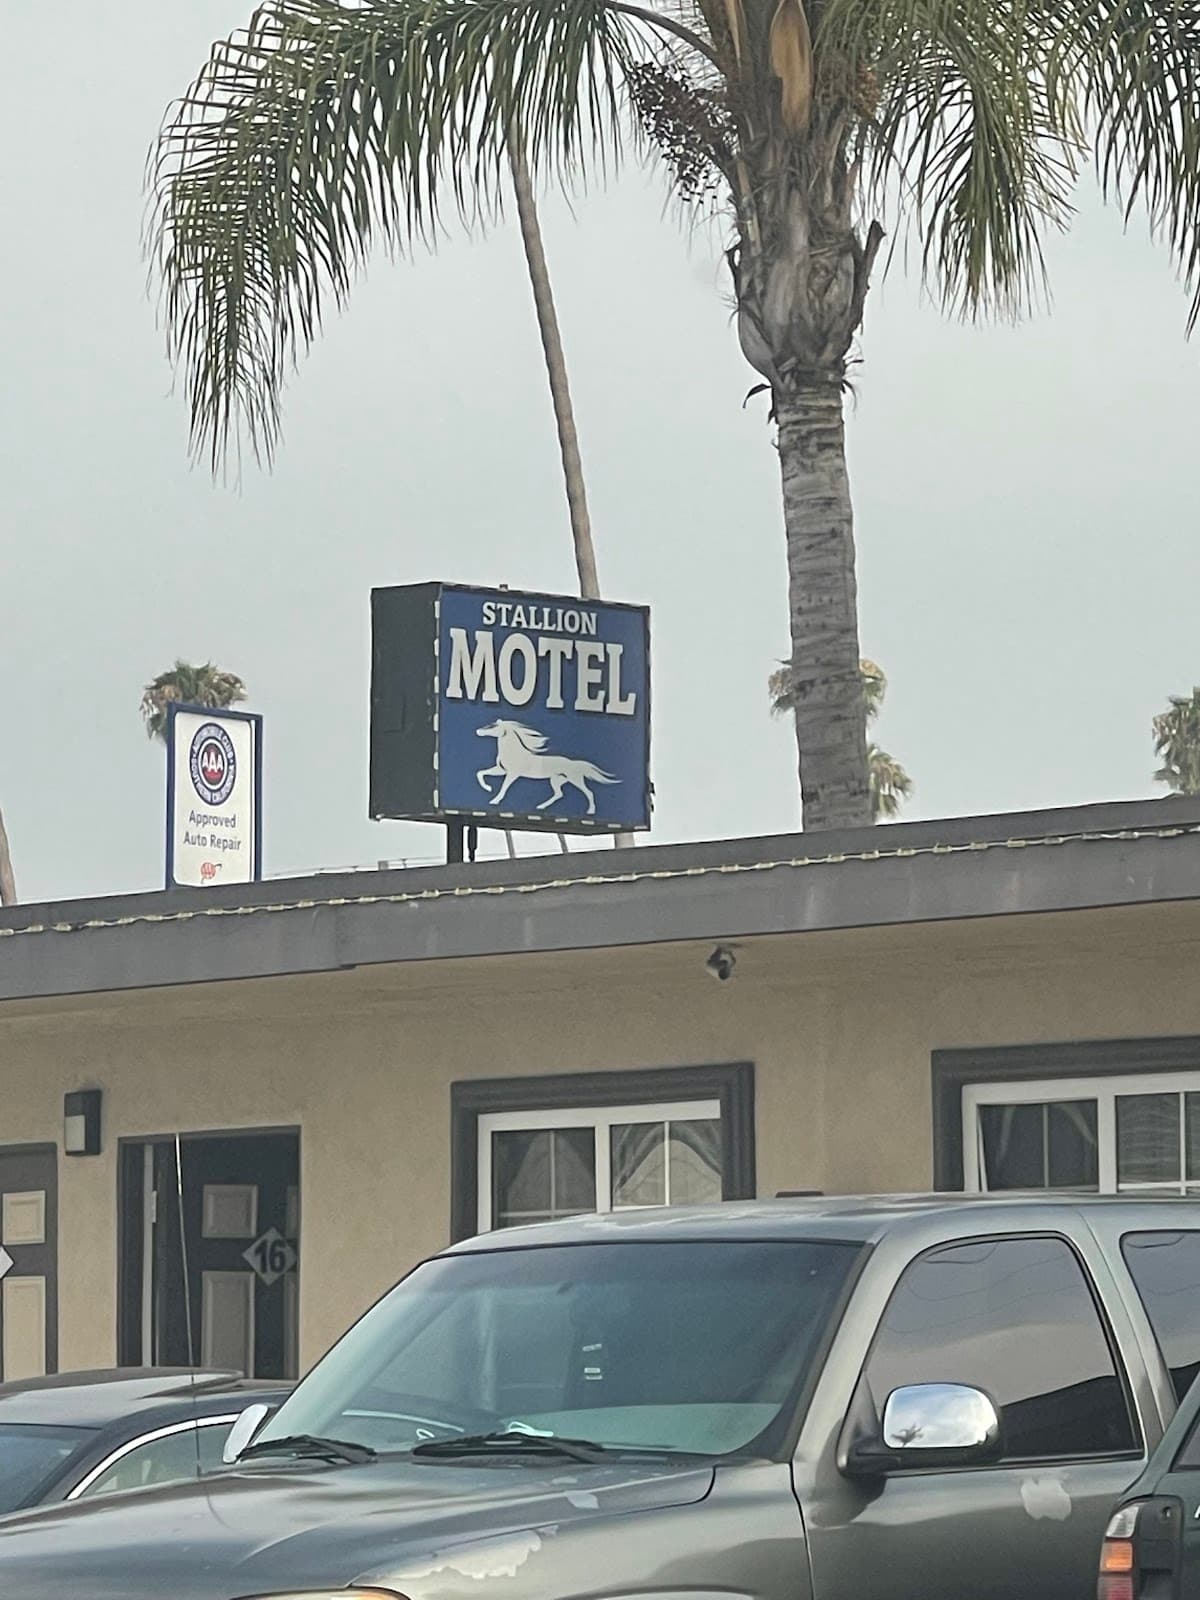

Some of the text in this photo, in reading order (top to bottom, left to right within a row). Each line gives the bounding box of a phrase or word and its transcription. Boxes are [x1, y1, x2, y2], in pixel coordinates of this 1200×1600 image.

[482, 601, 597, 635] STALLION
[446, 627, 636, 716] MOTEL
[202, 751, 224, 773] AAA
[189, 809, 236, 828] Approved
[183, 831, 241, 852] Auto Repair
[254, 1238, 288, 1274] 16
